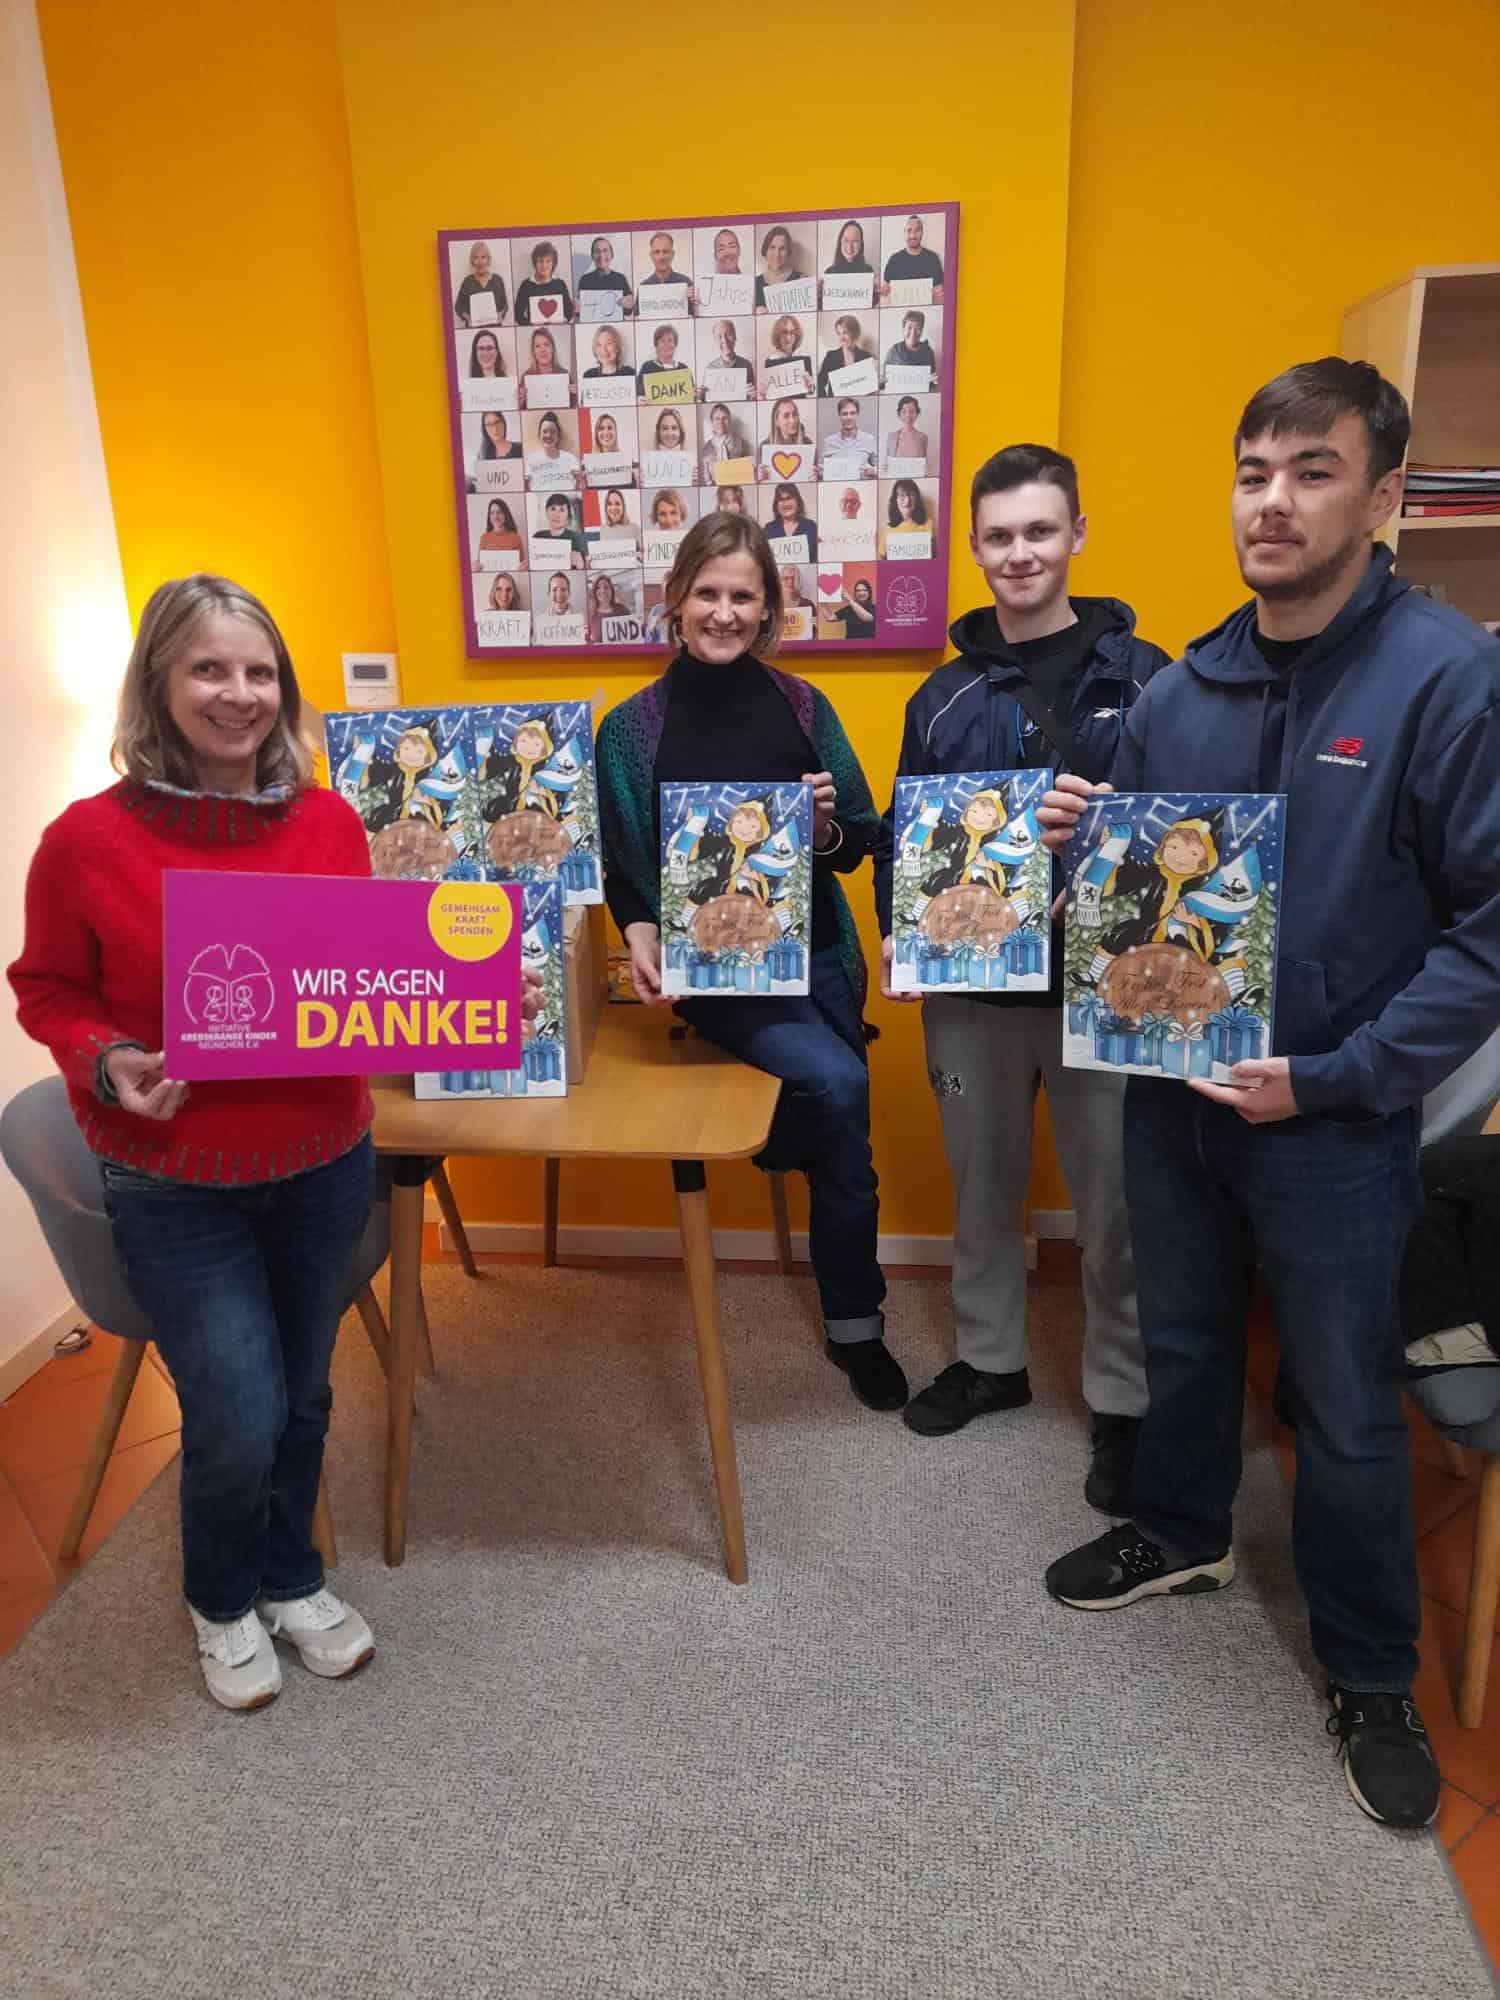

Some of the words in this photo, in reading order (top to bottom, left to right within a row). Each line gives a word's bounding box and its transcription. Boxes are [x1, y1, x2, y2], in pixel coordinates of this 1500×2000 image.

[767, 367, 802, 390] ALLE
[651, 385, 688, 401] DANK
[487, 470, 510, 485] UND
[606, 619, 640, 642] UND
[440, 904, 500, 914] GEMEINSAM
[454, 915, 487, 925] KRAFT
[447, 926, 494, 936] SPENDEN
[292, 969, 347, 997] WIR
[355, 968, 444, 996] SAGEN
[296, 999, 507, 1049] DANKE!
